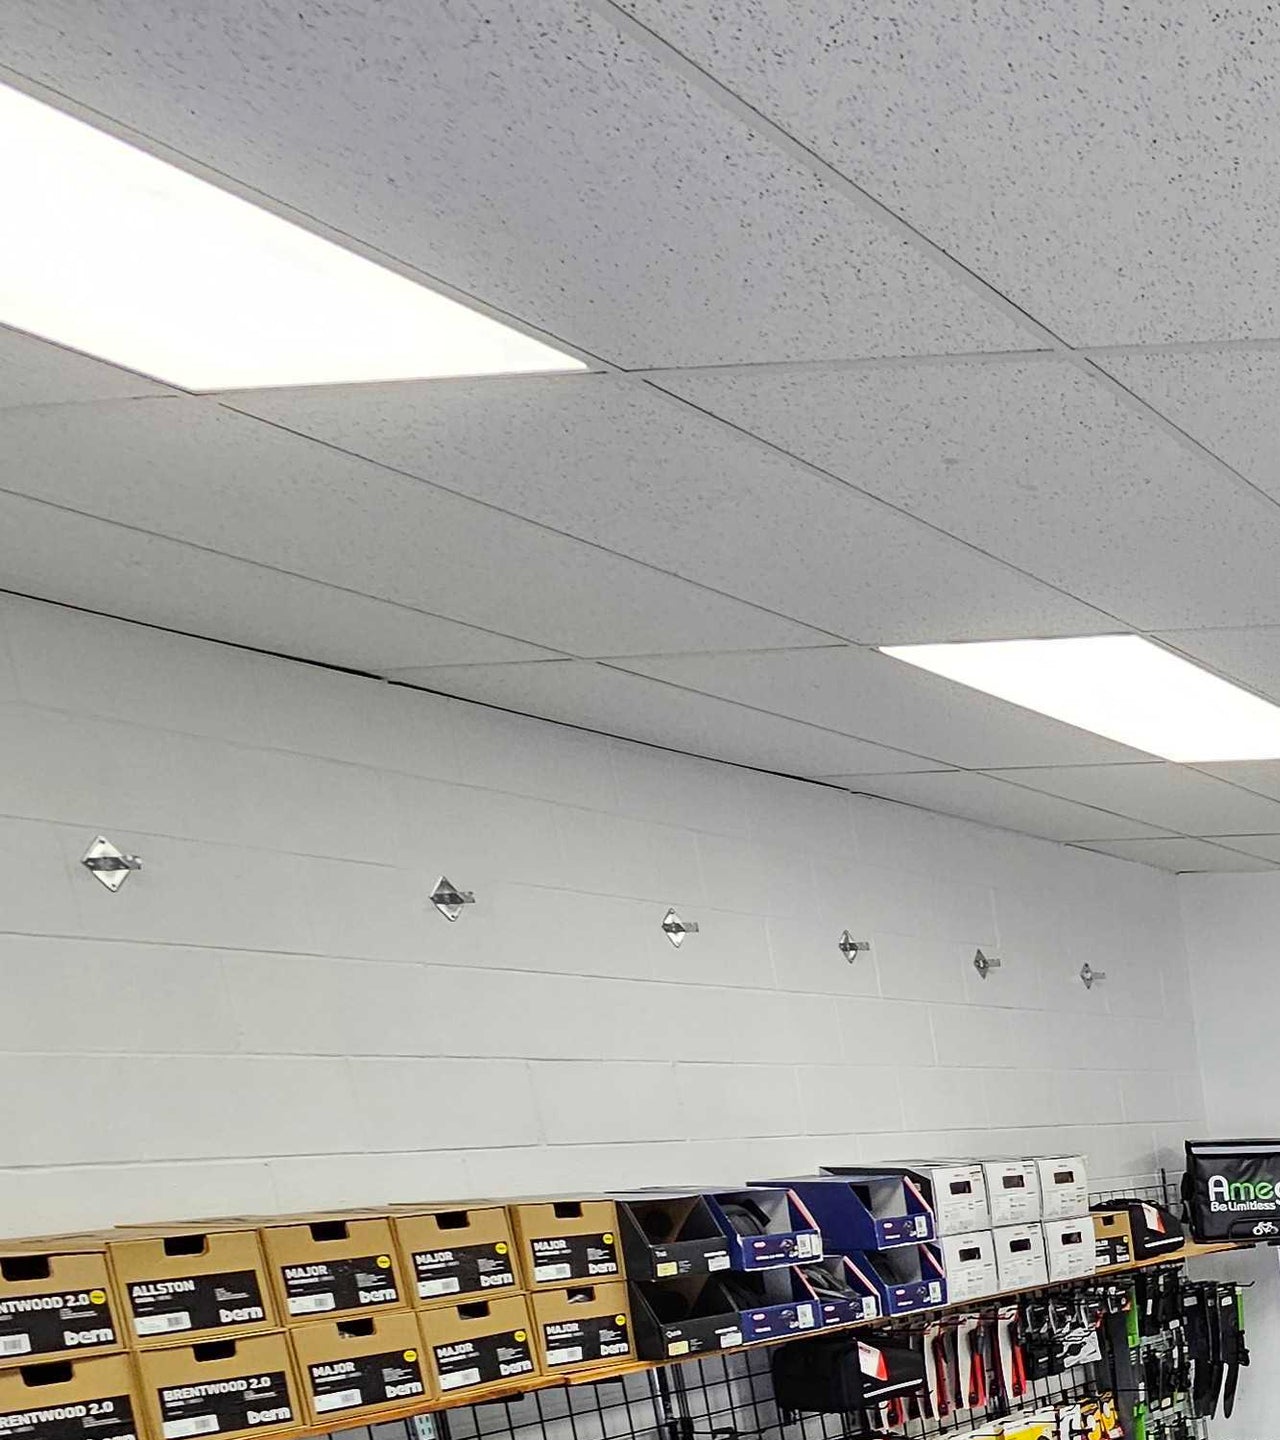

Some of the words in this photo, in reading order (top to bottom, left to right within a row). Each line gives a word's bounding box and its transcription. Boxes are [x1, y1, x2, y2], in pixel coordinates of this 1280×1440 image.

[1211, 1201, 1228, 1212] Be
[415, 1251, 454, 1265] MAJOR
[285, 1265, 328, 1279] MAJOR
[132, 1280, 195, 1297] ALLSTON
[359, 1288, 397, 1303] bern
[65, 1293, 90, 1308] 2.0
[219, 1306, 263, 1323] bern
[63, 1328, 114, 1346] bern
[436, 1343, 475, 1359] MAJOR
[312, 1362, 355, 1378] MAJOR
[163, 1380, 248, 1402] BRENTWOOD
[249, 1377, 271, 1389] 2.0
[385, 1381, 423, 1398] bern
[88, 1401, 114, 1415] 2.0
[247, 1406, 291, 1425] bern
